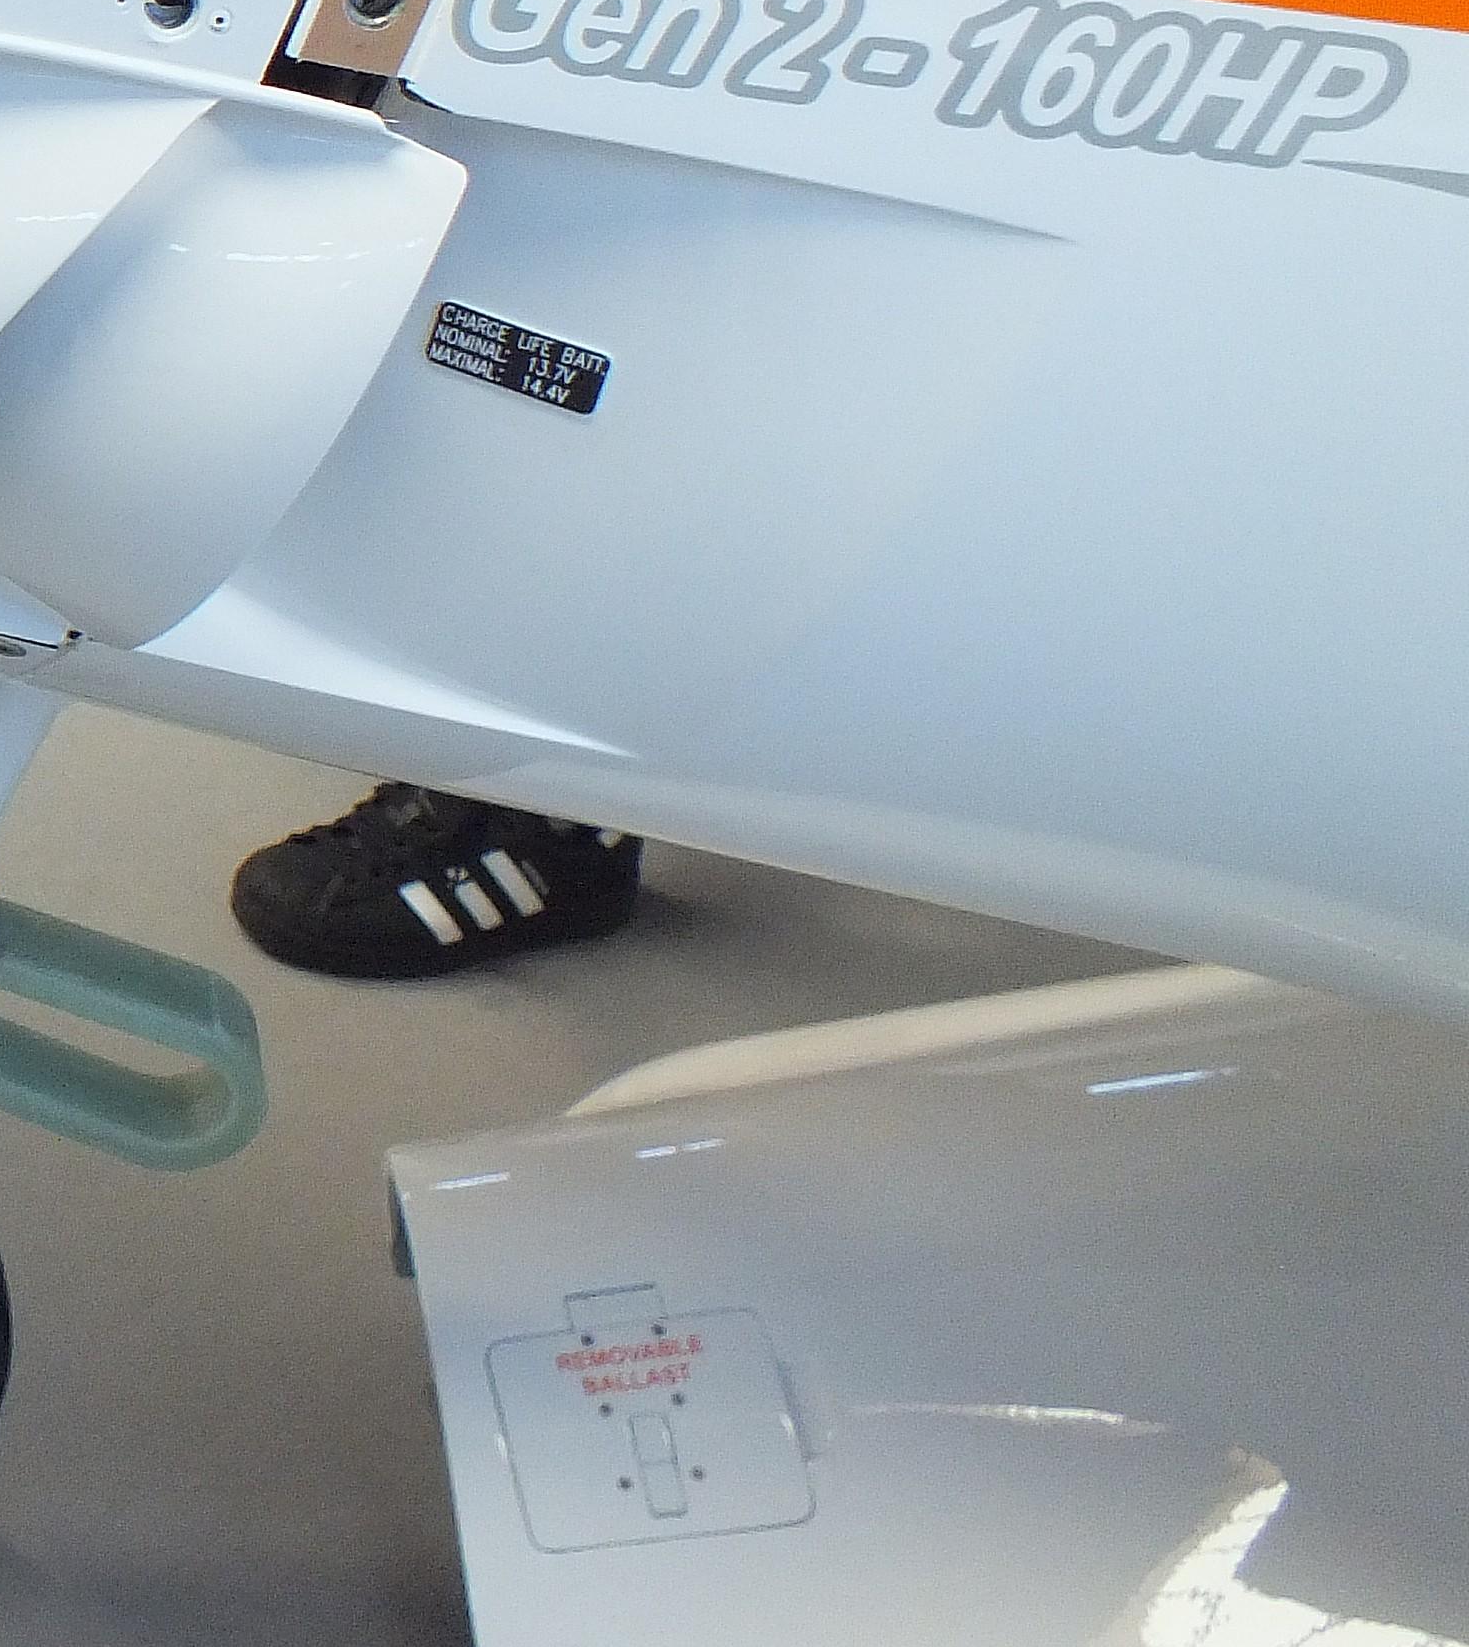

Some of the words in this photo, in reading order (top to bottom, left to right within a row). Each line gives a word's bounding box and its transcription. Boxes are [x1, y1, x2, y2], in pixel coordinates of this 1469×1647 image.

[442, 304, 512, 343] CHARGE
[517, 331, 555, 358] LIFE
[556, 1334, 703, 1371] REMOVABLE
[582, 1362, 690, 1394] BALLAST
